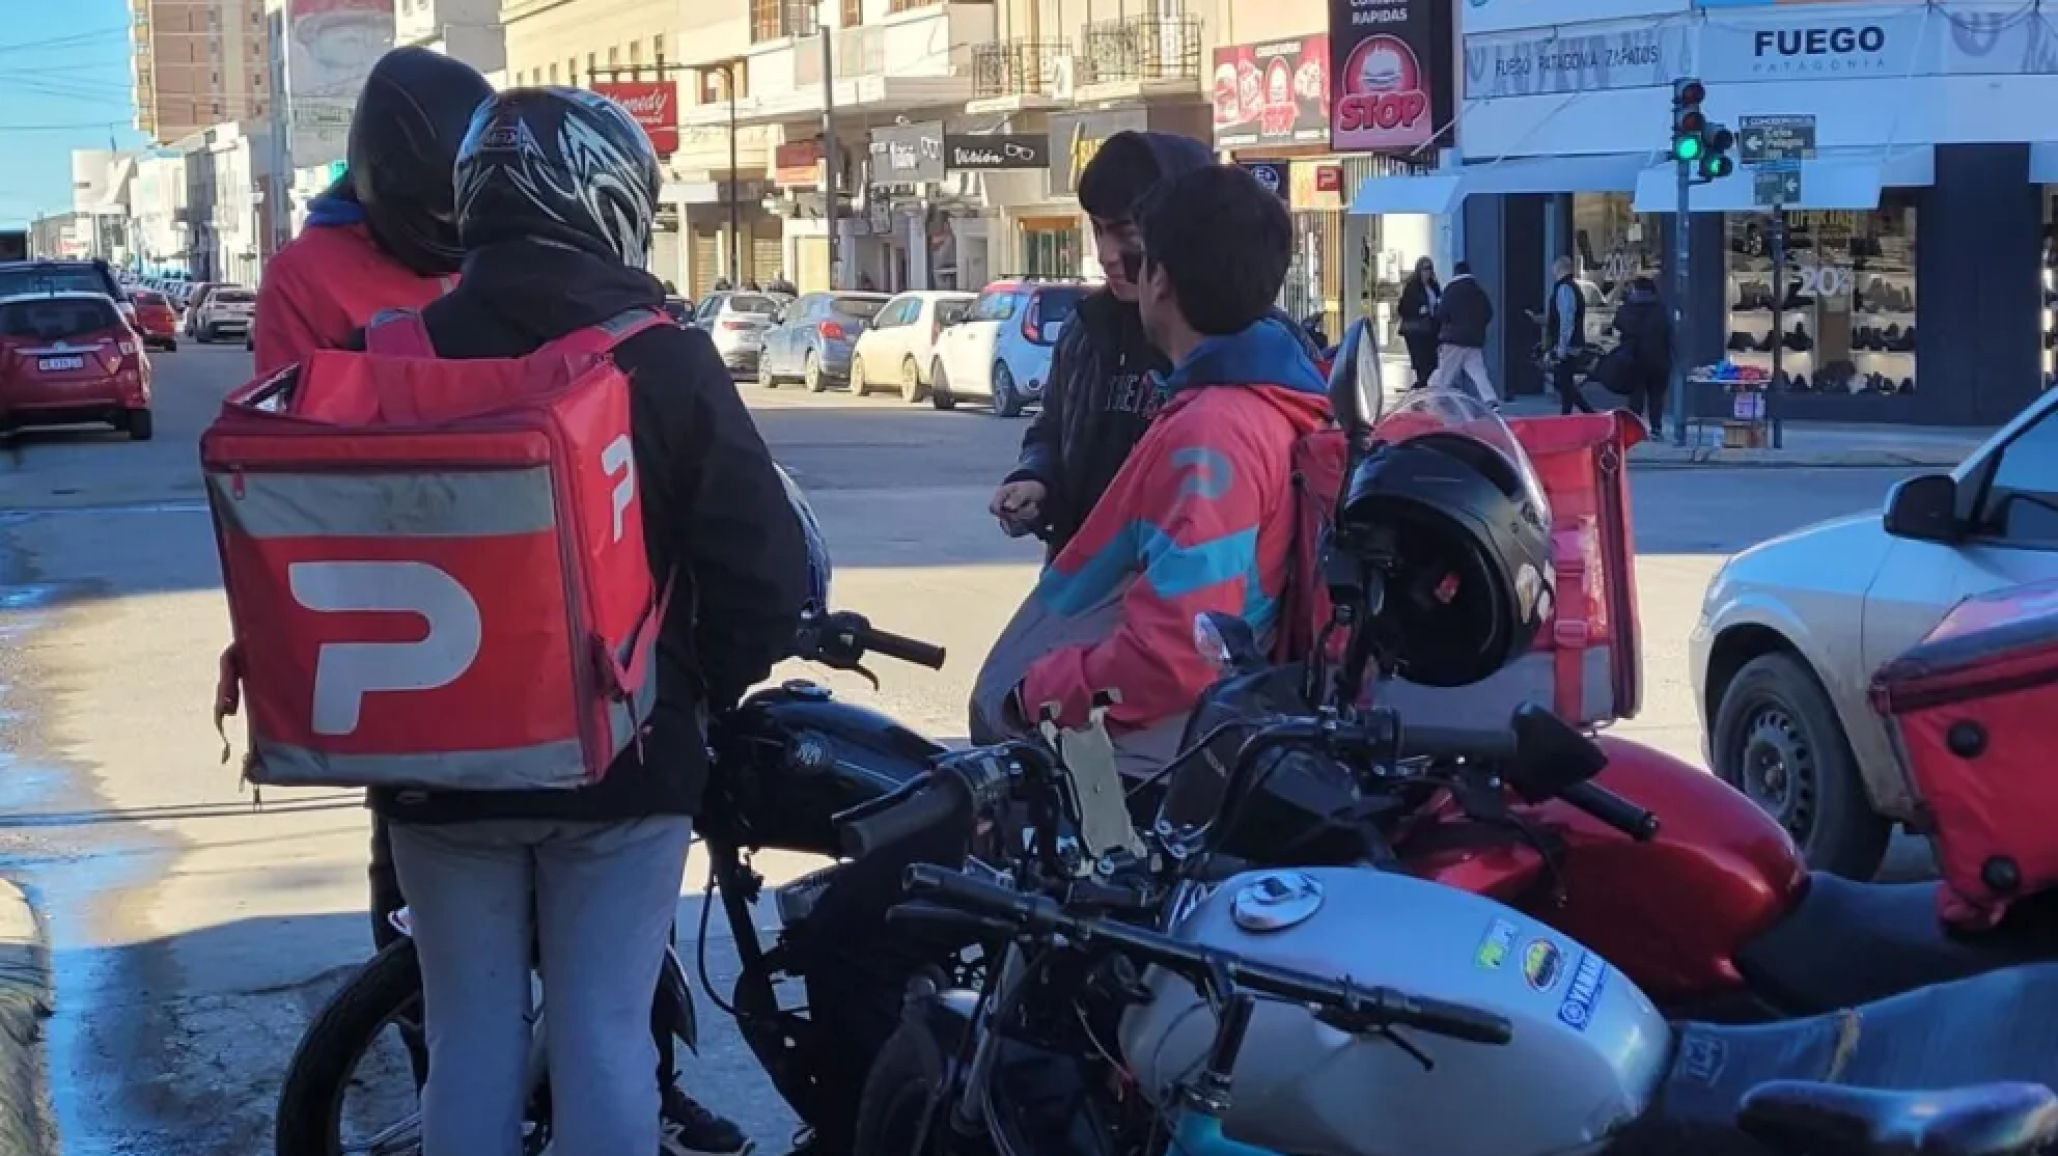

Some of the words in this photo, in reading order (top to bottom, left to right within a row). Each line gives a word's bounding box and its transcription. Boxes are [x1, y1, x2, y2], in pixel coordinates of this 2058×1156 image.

[1352, 8, 1407, 24] RAPIDAS
[1754, 26, 1885, 56] FUEGO
[1495, 57, 1531, 77] FUEGO
[1538, 51, 1598, 71] PATAGONIA
[1605, 45, 1659, 68] ZAPATOS
[1752, 58, 1885, 72] PATAGONIA
[1340, 94, 1425, 131] STOP
[288, 561, 482, 736] P
